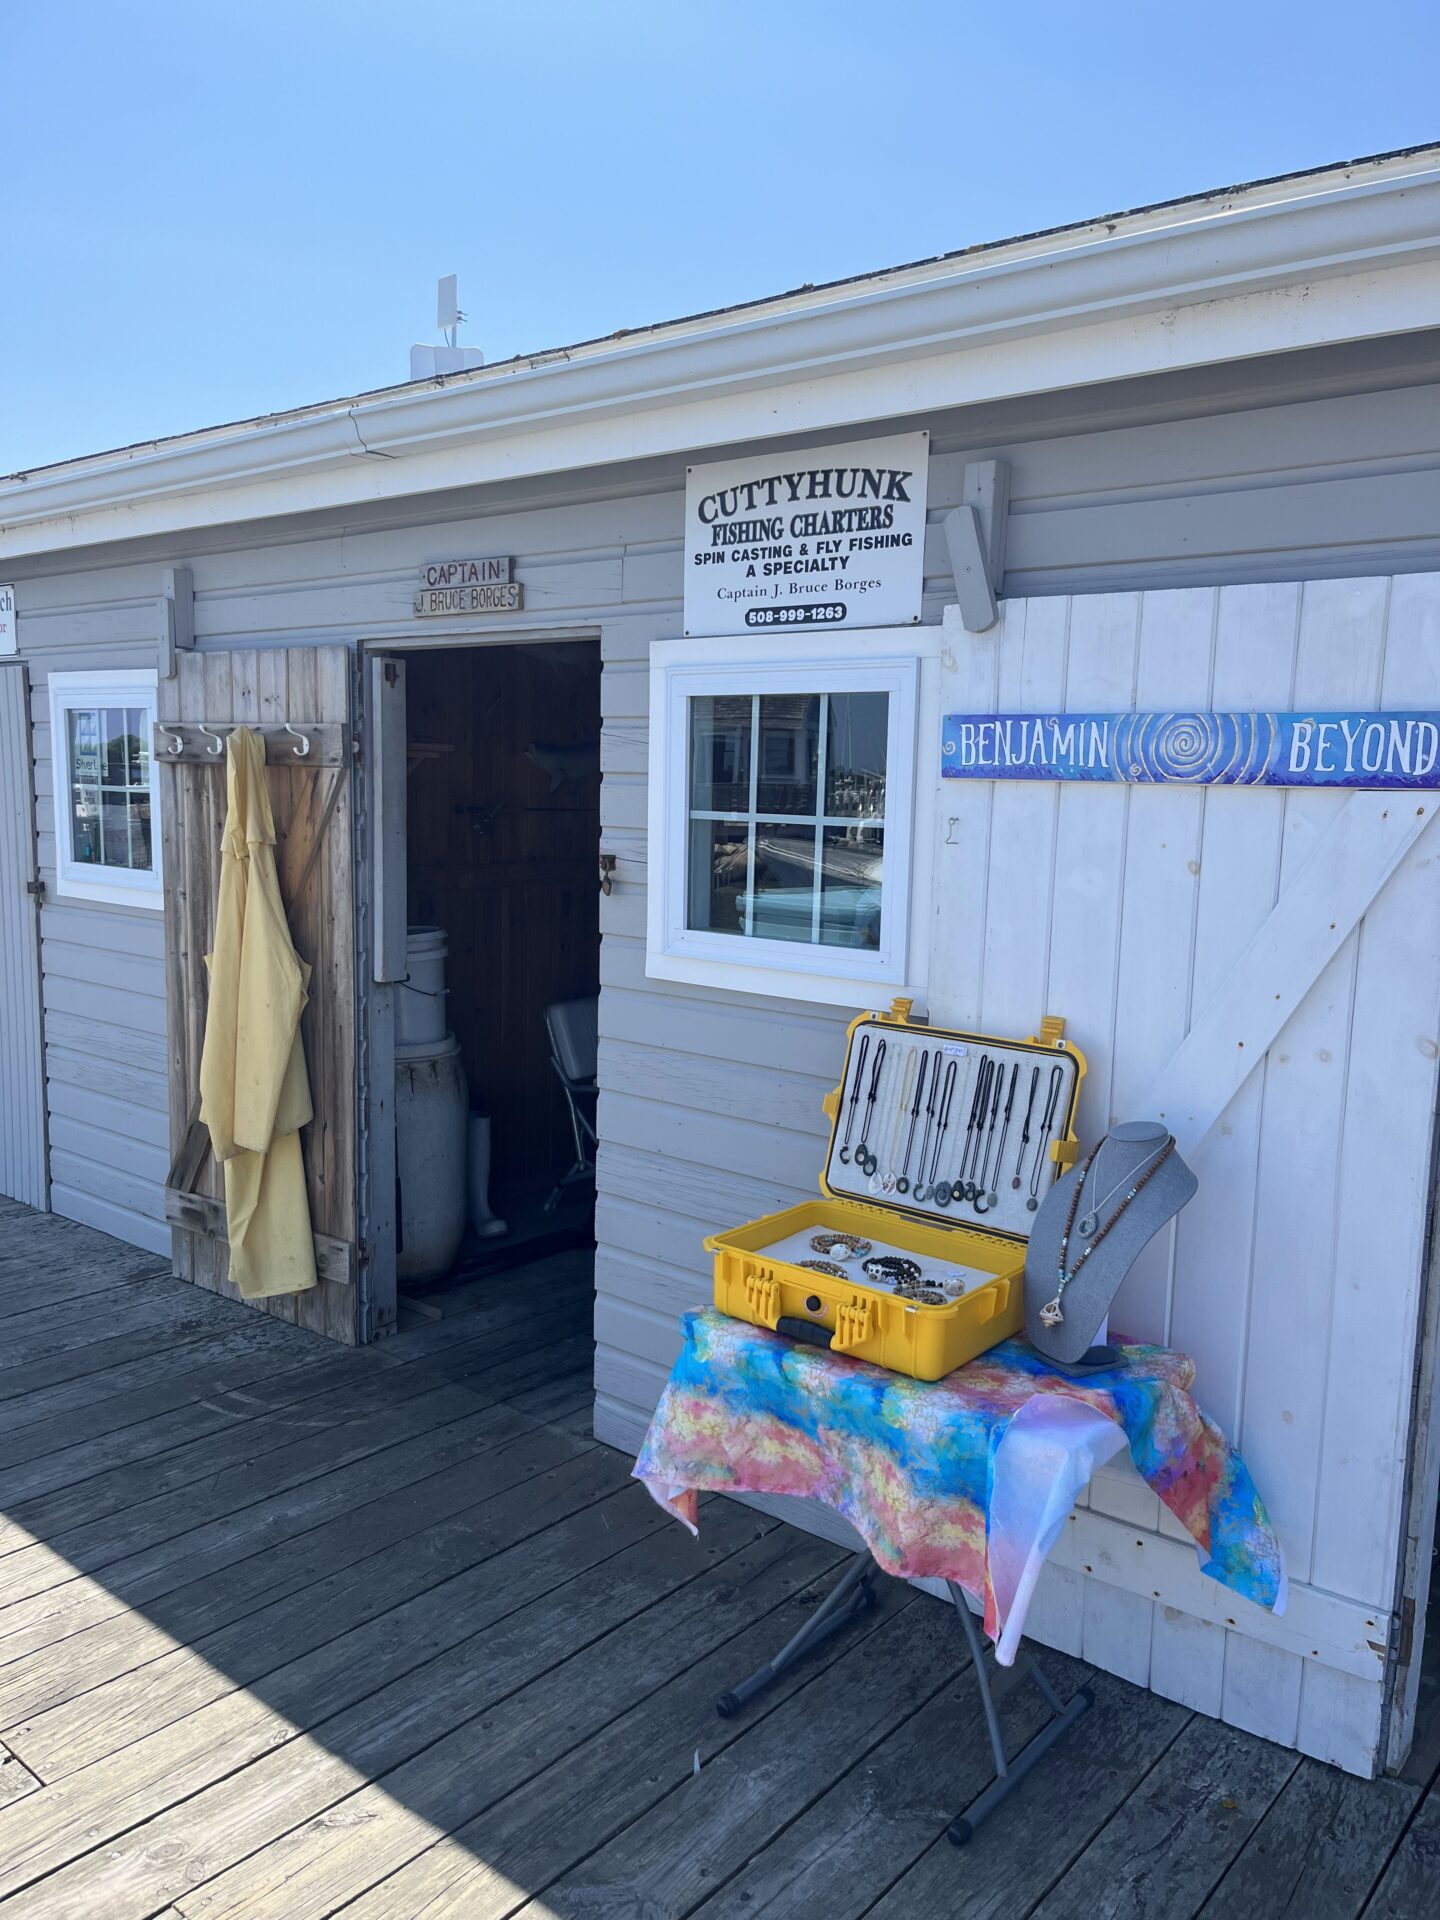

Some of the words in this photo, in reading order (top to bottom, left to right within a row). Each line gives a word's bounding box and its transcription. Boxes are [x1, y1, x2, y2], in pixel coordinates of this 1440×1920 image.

[698, 468, 913, 524] CUTTYHUNK
[711, 516, 785, 546] FISHING
[789, 504, 894, 539] CHARTERS
[694, 552, 725, 566] SPIN
[731, 544, 793, 562] CASTING
[799, 543, 809, 556] &
[816, 540, 842, 555] FLY
[849, 532, 913, 551] FISHING
[427, 560, 500, 586] CAPTAIN
[745, 564, 757, 578] A
[763, 556, 850, 577] SPECIALTY
[415, 593, 426, 613] J.
[430, 589, 466, 612] BRUCE
[470, 585, 516, 609] BORGES
[717, 585, 768, 602] Captain
[771, 583, 783, 599] J.
[788, 581, 828, 595] Bruce
[834, 577, 882, 595] Borges
[748, 605, 843, 624] 508-999-1263
[960, 718, 1109, 768] BENJAMIN
[1288, 718, 1439, 776] BEYOND
